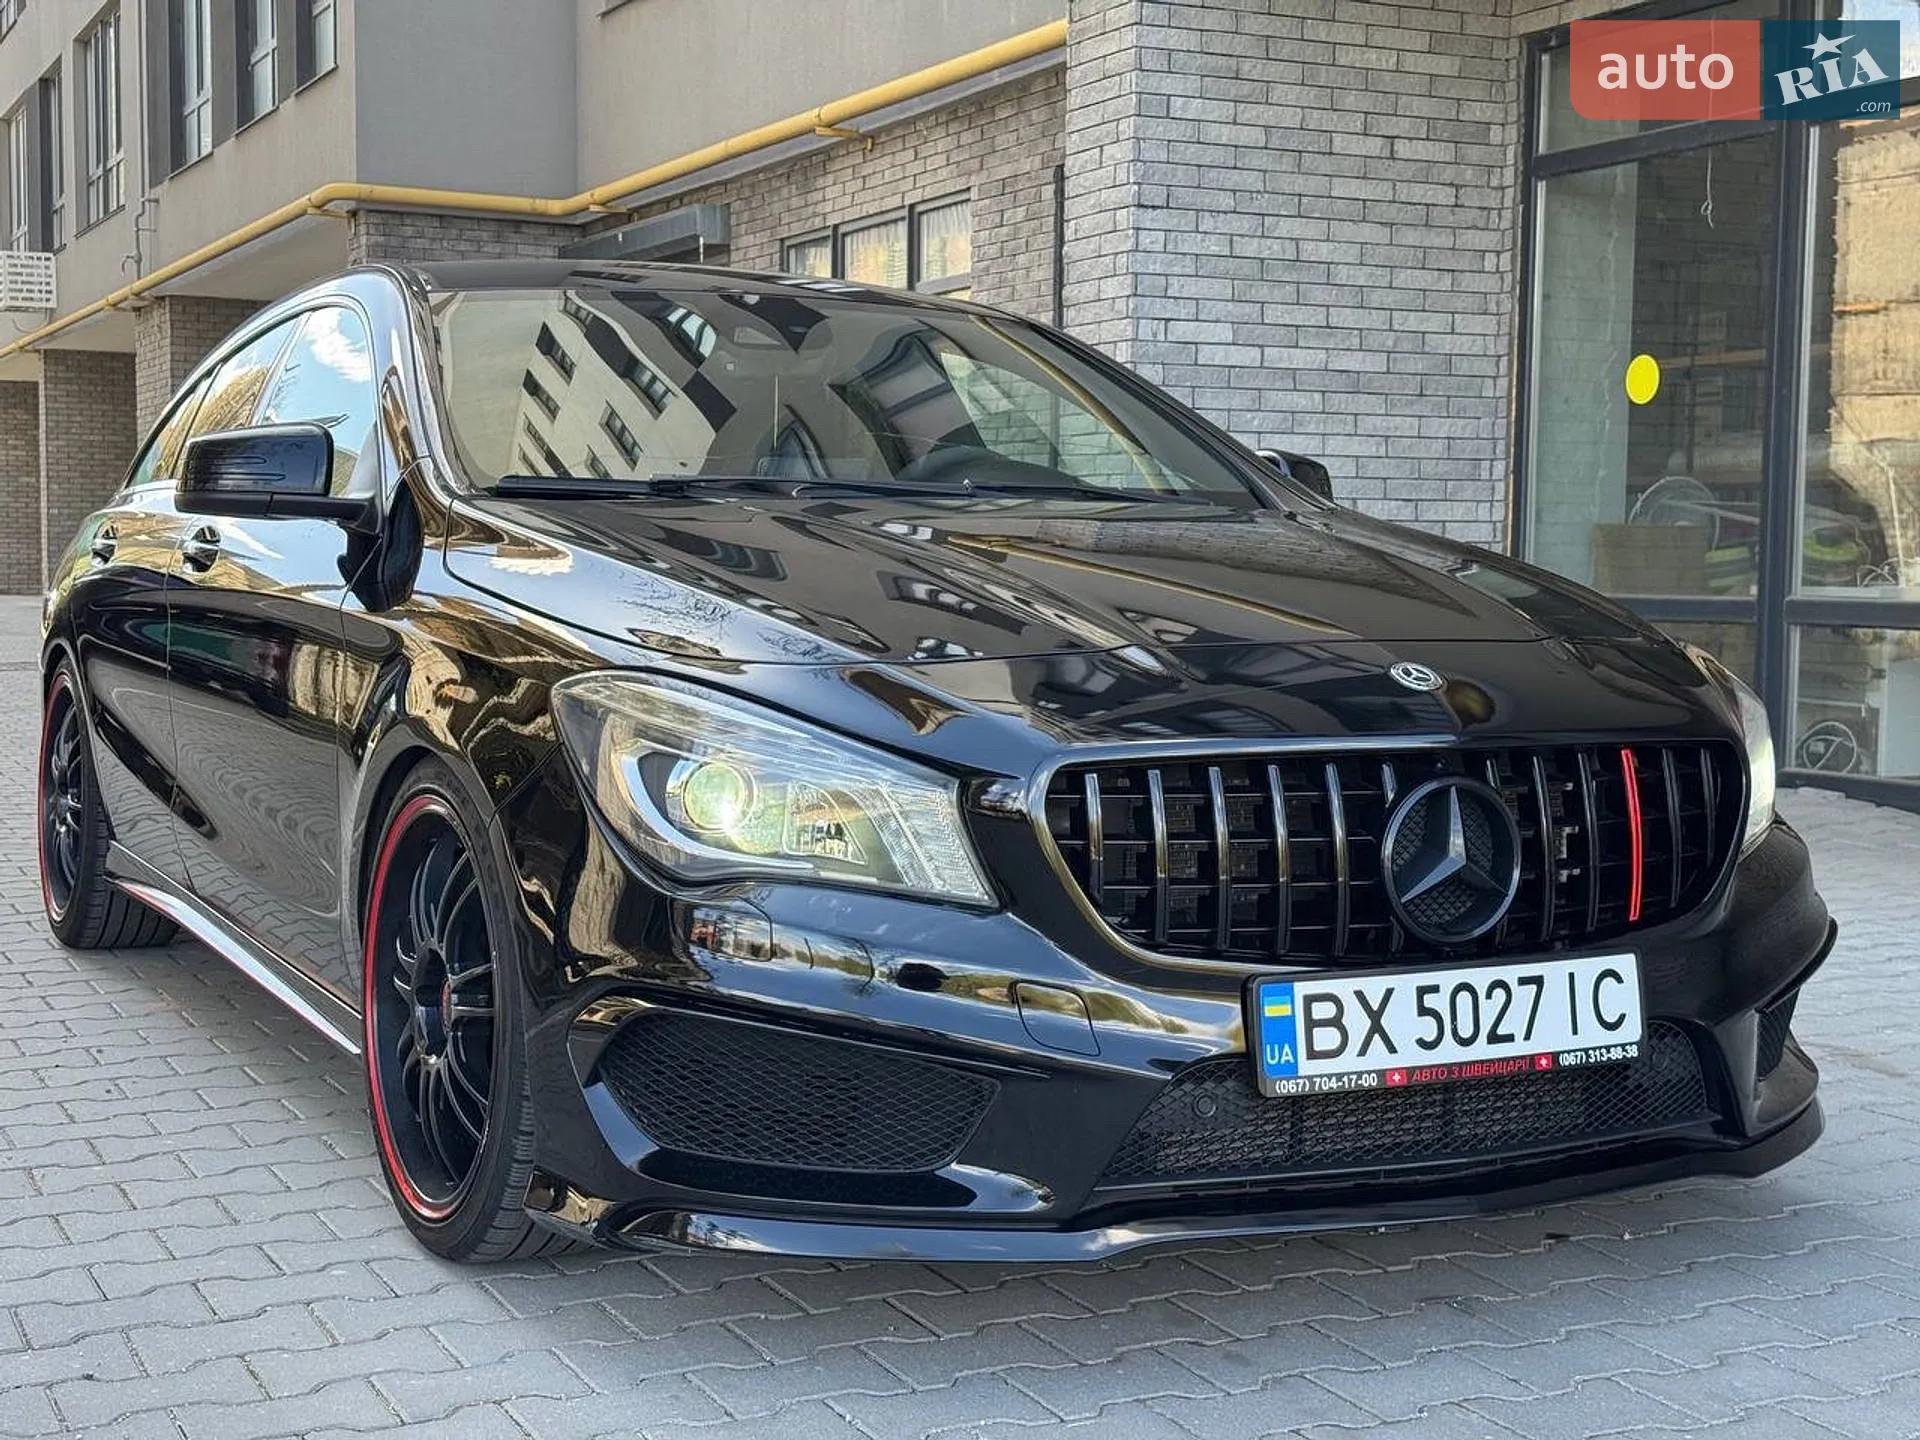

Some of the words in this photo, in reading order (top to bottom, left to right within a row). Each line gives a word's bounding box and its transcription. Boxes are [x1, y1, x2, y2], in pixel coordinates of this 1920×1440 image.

[1302, 986, 1398, 1061] BX
[1414, 974, 1545, 1051] 5027
[1568, 968, 1627, 1036] IC
[1267, 1043, 1294, 1065] UA
[1559, 1051, 1586, 1066] (067)
[1275, 1079, 1310, 1093] (067)
[1313, 1072, 1378, 1091] 704-17-00
[1411, 1068, 1448, 1081] АВТО
